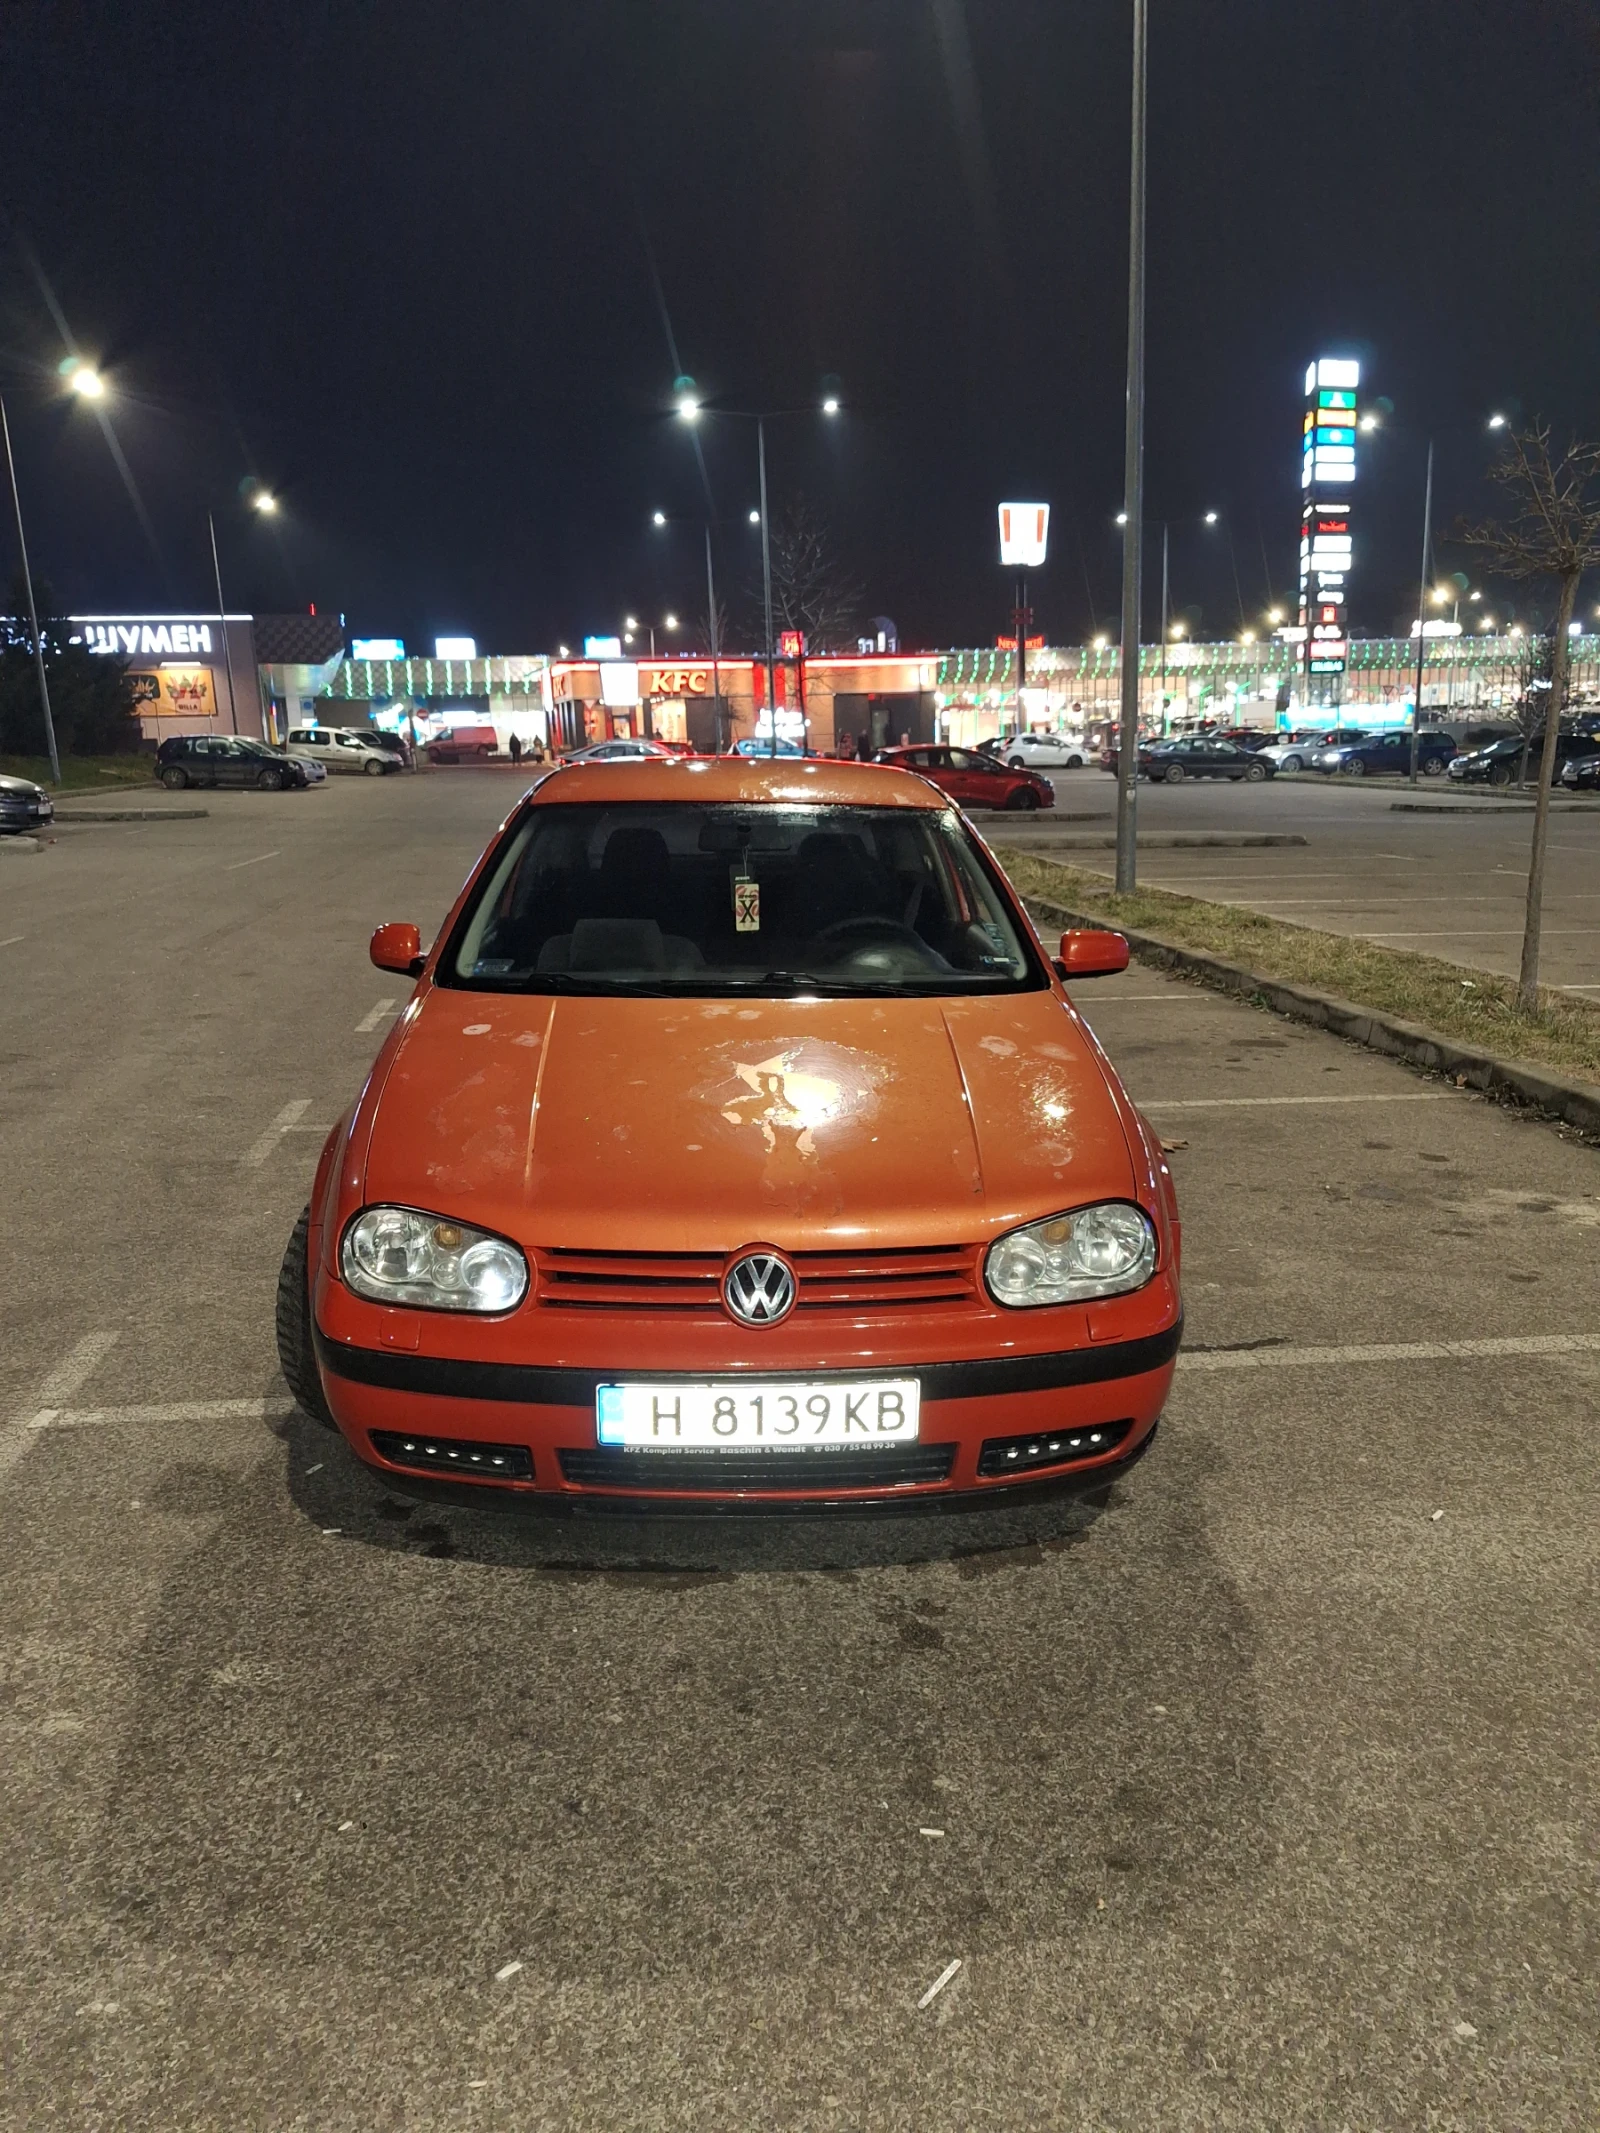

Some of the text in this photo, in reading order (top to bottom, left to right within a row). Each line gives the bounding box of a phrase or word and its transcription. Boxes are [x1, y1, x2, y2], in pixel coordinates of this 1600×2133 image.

[85, 624, 212, 653] ШУМЕН
[650, 671, 707, 692] KFC
[739, 899, 757, 923] X
[726, 1255, 794, 1324] VW
[652, 1390, 905, 1436] H 8139 KB
[623, 1446, 641, 1454] KFZ
[642, 1447, 682, 1456] Komplett
[684, 1447, 715, 1455] Service
[764, 1446, 771, 1454] &
[824, 1444, 840, 1453] 030
